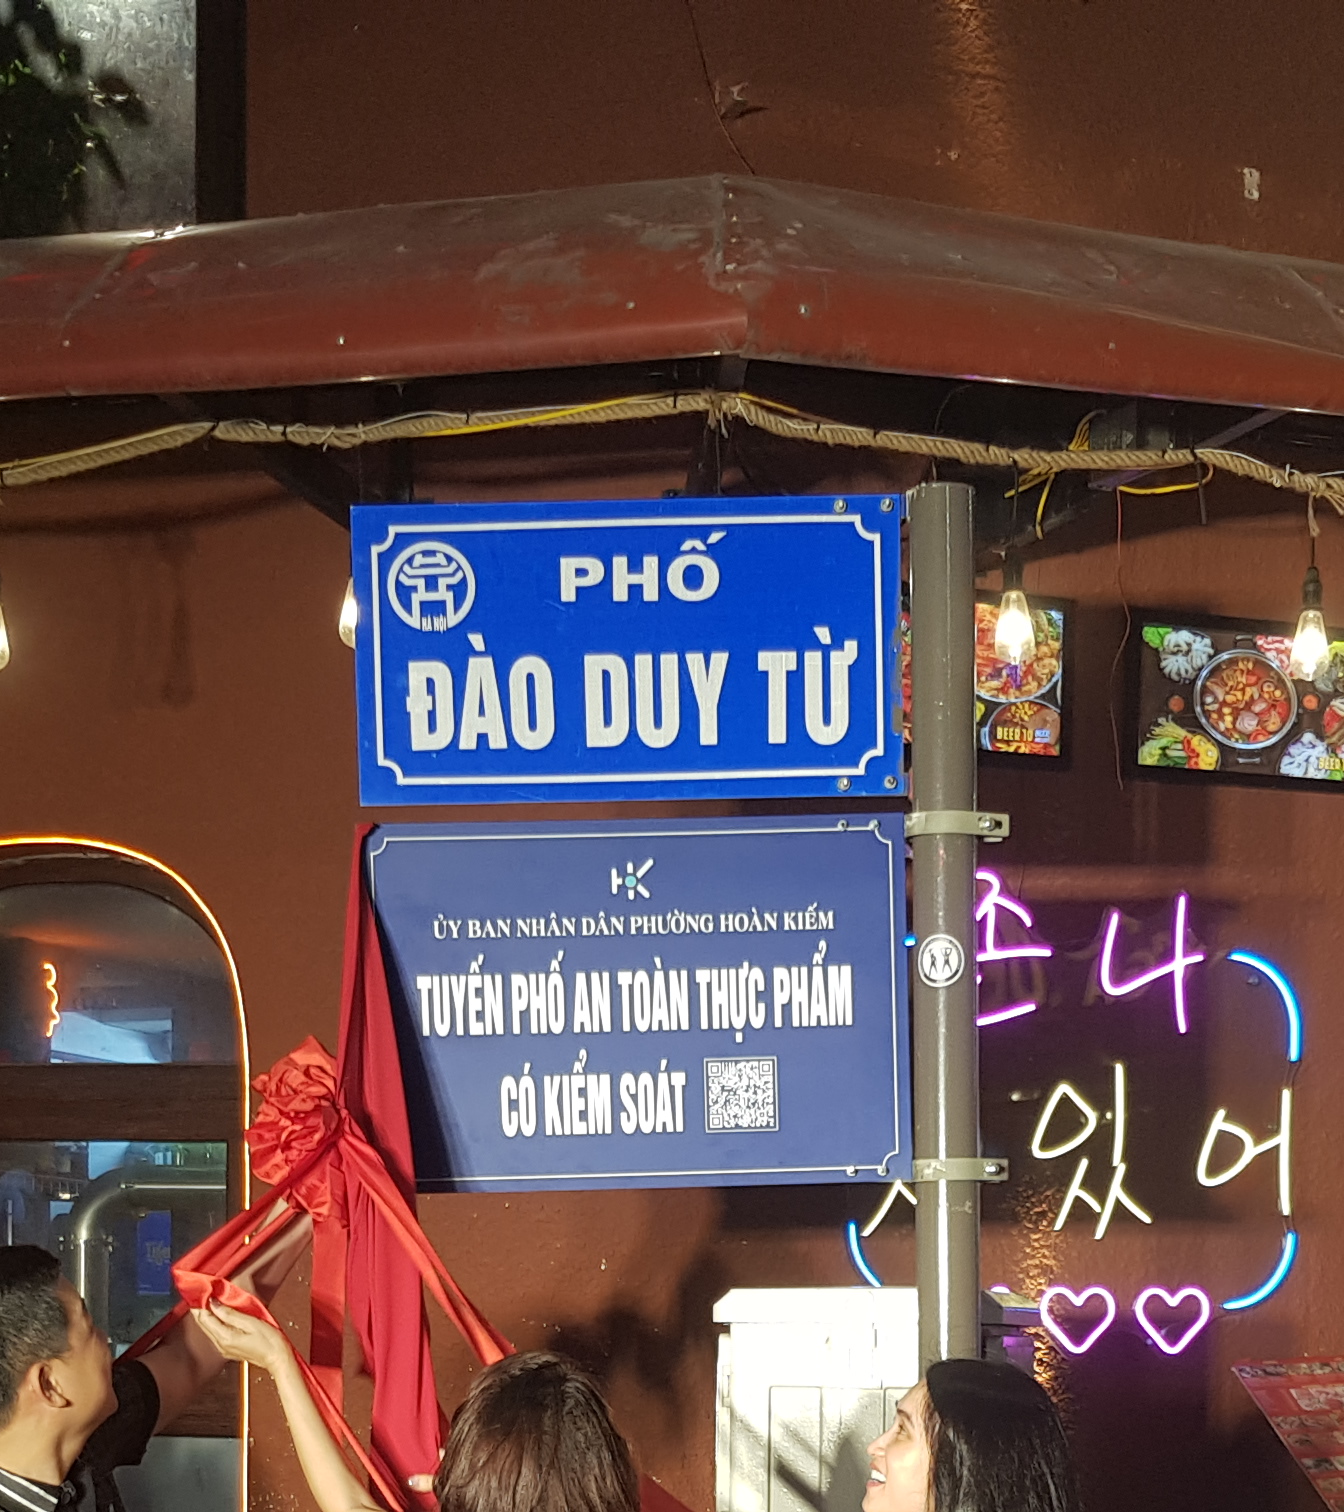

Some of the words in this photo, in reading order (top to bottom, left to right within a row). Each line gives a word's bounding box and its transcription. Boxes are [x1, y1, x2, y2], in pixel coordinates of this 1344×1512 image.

[559, 531, 728, 602] PHỐ
[406, 632, 556, 752] ĐÀO
[583, 650, 730, 750] DUY
[757, 626, 858, 747] TỪ
[433, 914, 462, 939] ỦY
[467, 919, 511, 939] BAN
[516, 911, 576, 938] NHÂN
[581, 910, 624, 937] DÂN
[630, 908, 715, 935] PHƯỜNG
[719, 906, 778, 933] HOÀN
[783, 902, 835, 932] KIẾM
[416, 953, 504, 1037] TUYẾN
[510, 949, 565, 1035] PHỐ
[573, 971, 612, 1034] AN
[617, 956, 690, 1032] TOÀN
[695, 960, 766, 1043] THỰC
[772, 939, 854, 1029] PHẨM
[500, 1062, 537, 1138] CÓ
[543, 1048, 613, 1136] KIỂM
[619, 1058, 687, 1135] SOÁT
